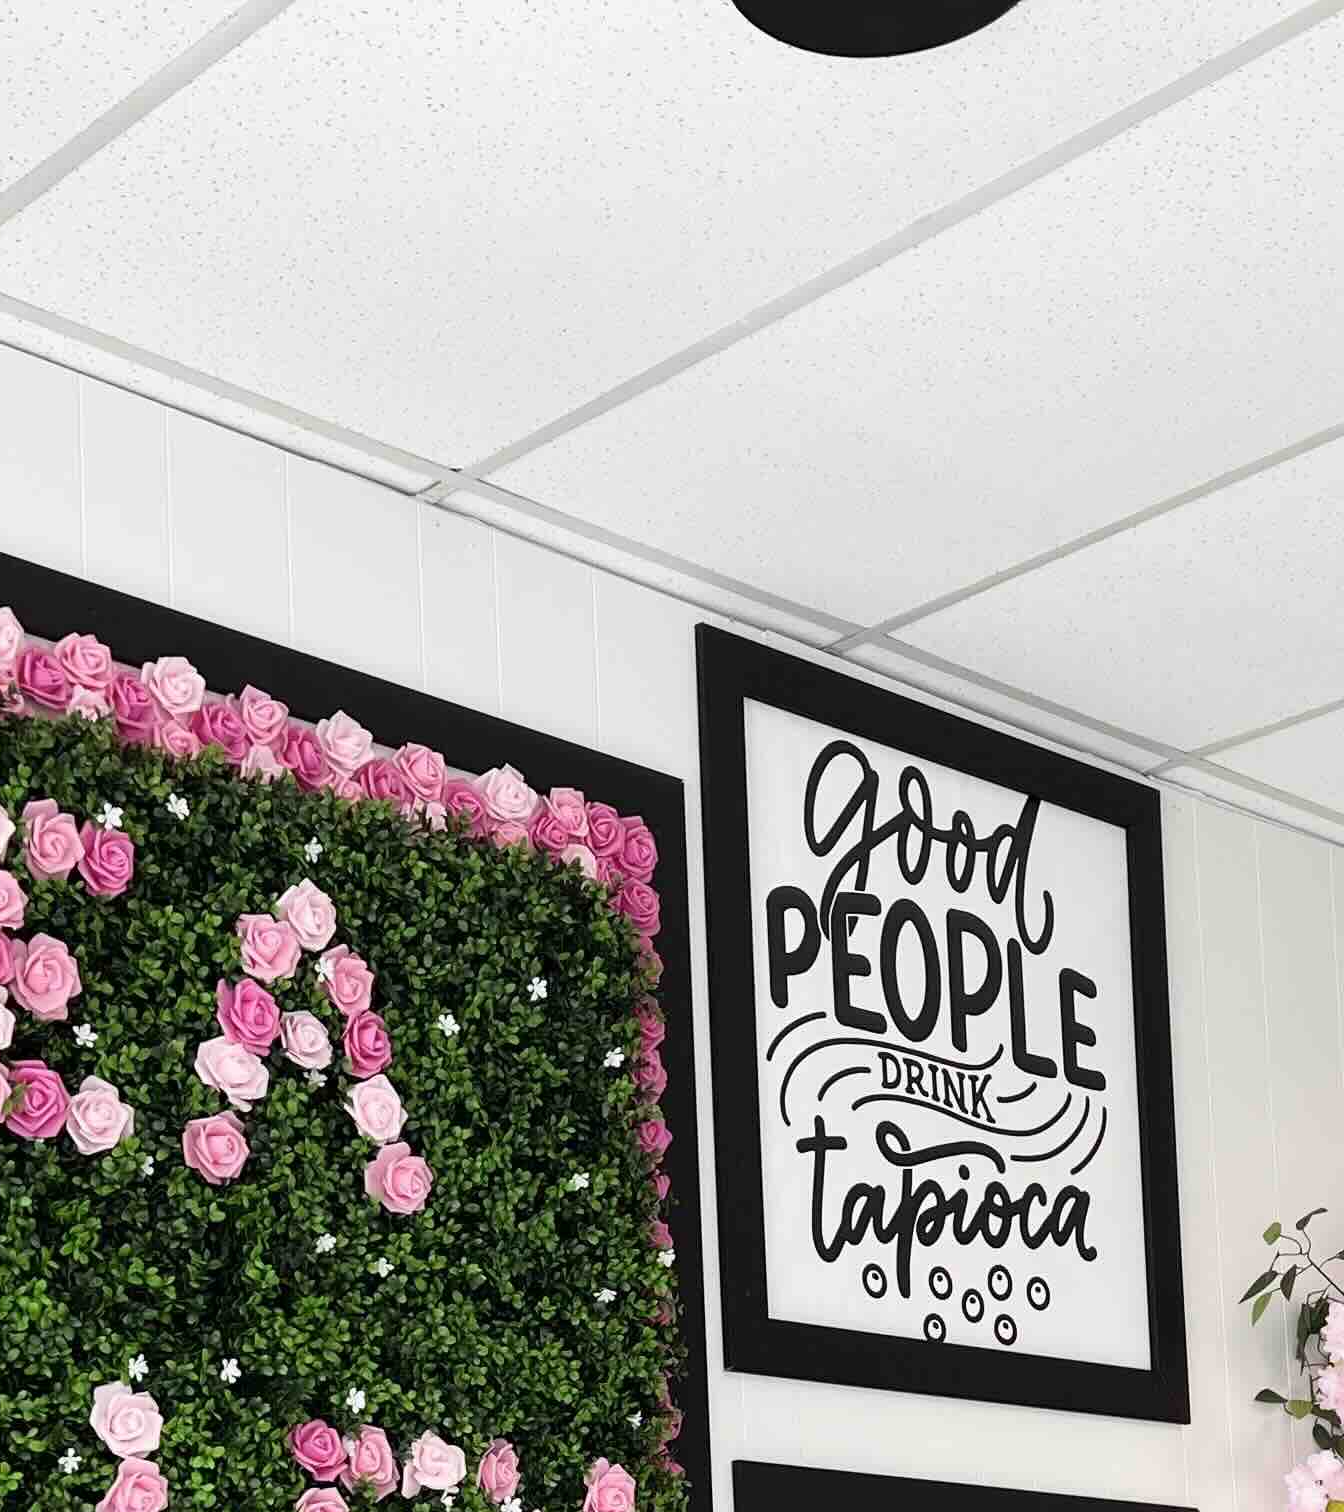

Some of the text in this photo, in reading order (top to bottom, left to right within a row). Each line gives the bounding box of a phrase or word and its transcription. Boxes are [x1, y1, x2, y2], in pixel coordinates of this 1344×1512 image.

[804, 739, 1055, 955] good
[765, 884, 1107, 1092] PEOPLE
[877, 1051, 997, 1124] DRINK
[795, 1115, 1099, 1299] tapioca
